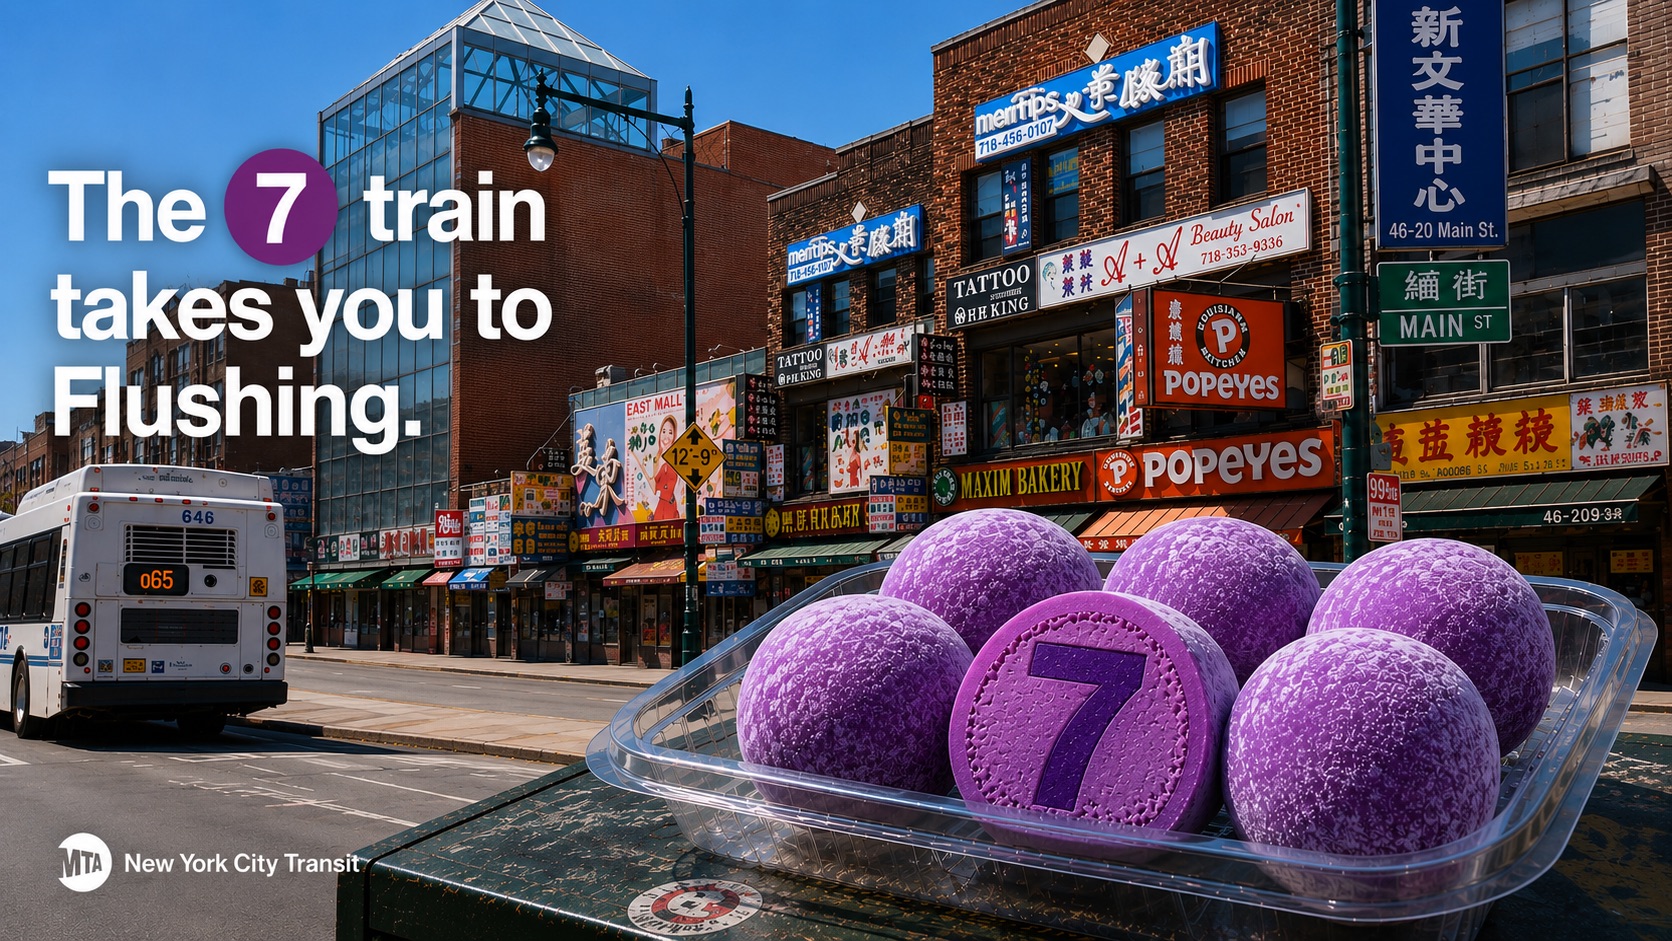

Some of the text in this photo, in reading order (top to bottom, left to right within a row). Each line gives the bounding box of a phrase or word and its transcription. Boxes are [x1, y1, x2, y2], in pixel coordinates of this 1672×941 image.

[1411, 6, 1466, 213] 新文華中心
[1389, 221, 1498, 239] 46-20 Main St.
[1101, 240, 1129, 287] A
[1152, 226, 1183, 275] A
[1190, 220, 1243, 246] Beauty
[1249, 204, 1294, 232] Salon
[1201, 235, 1283, 265] 718-353-9336
[953, 264, 1031, 299] TATTOO
[990, 296, 1029, 318] KING
[1400, 314, 1493, 339] MAIN ST
[777, 348, 823, 369] TATTOO
[626, 394, 683, 416] EAST MALL
[961, 467, 1011, 499] MAXIM
[1017, 461, 1083, 495] BAKERY
[182, 509, 214, 525] 646
[1028, 641, 1148, 813] 7
